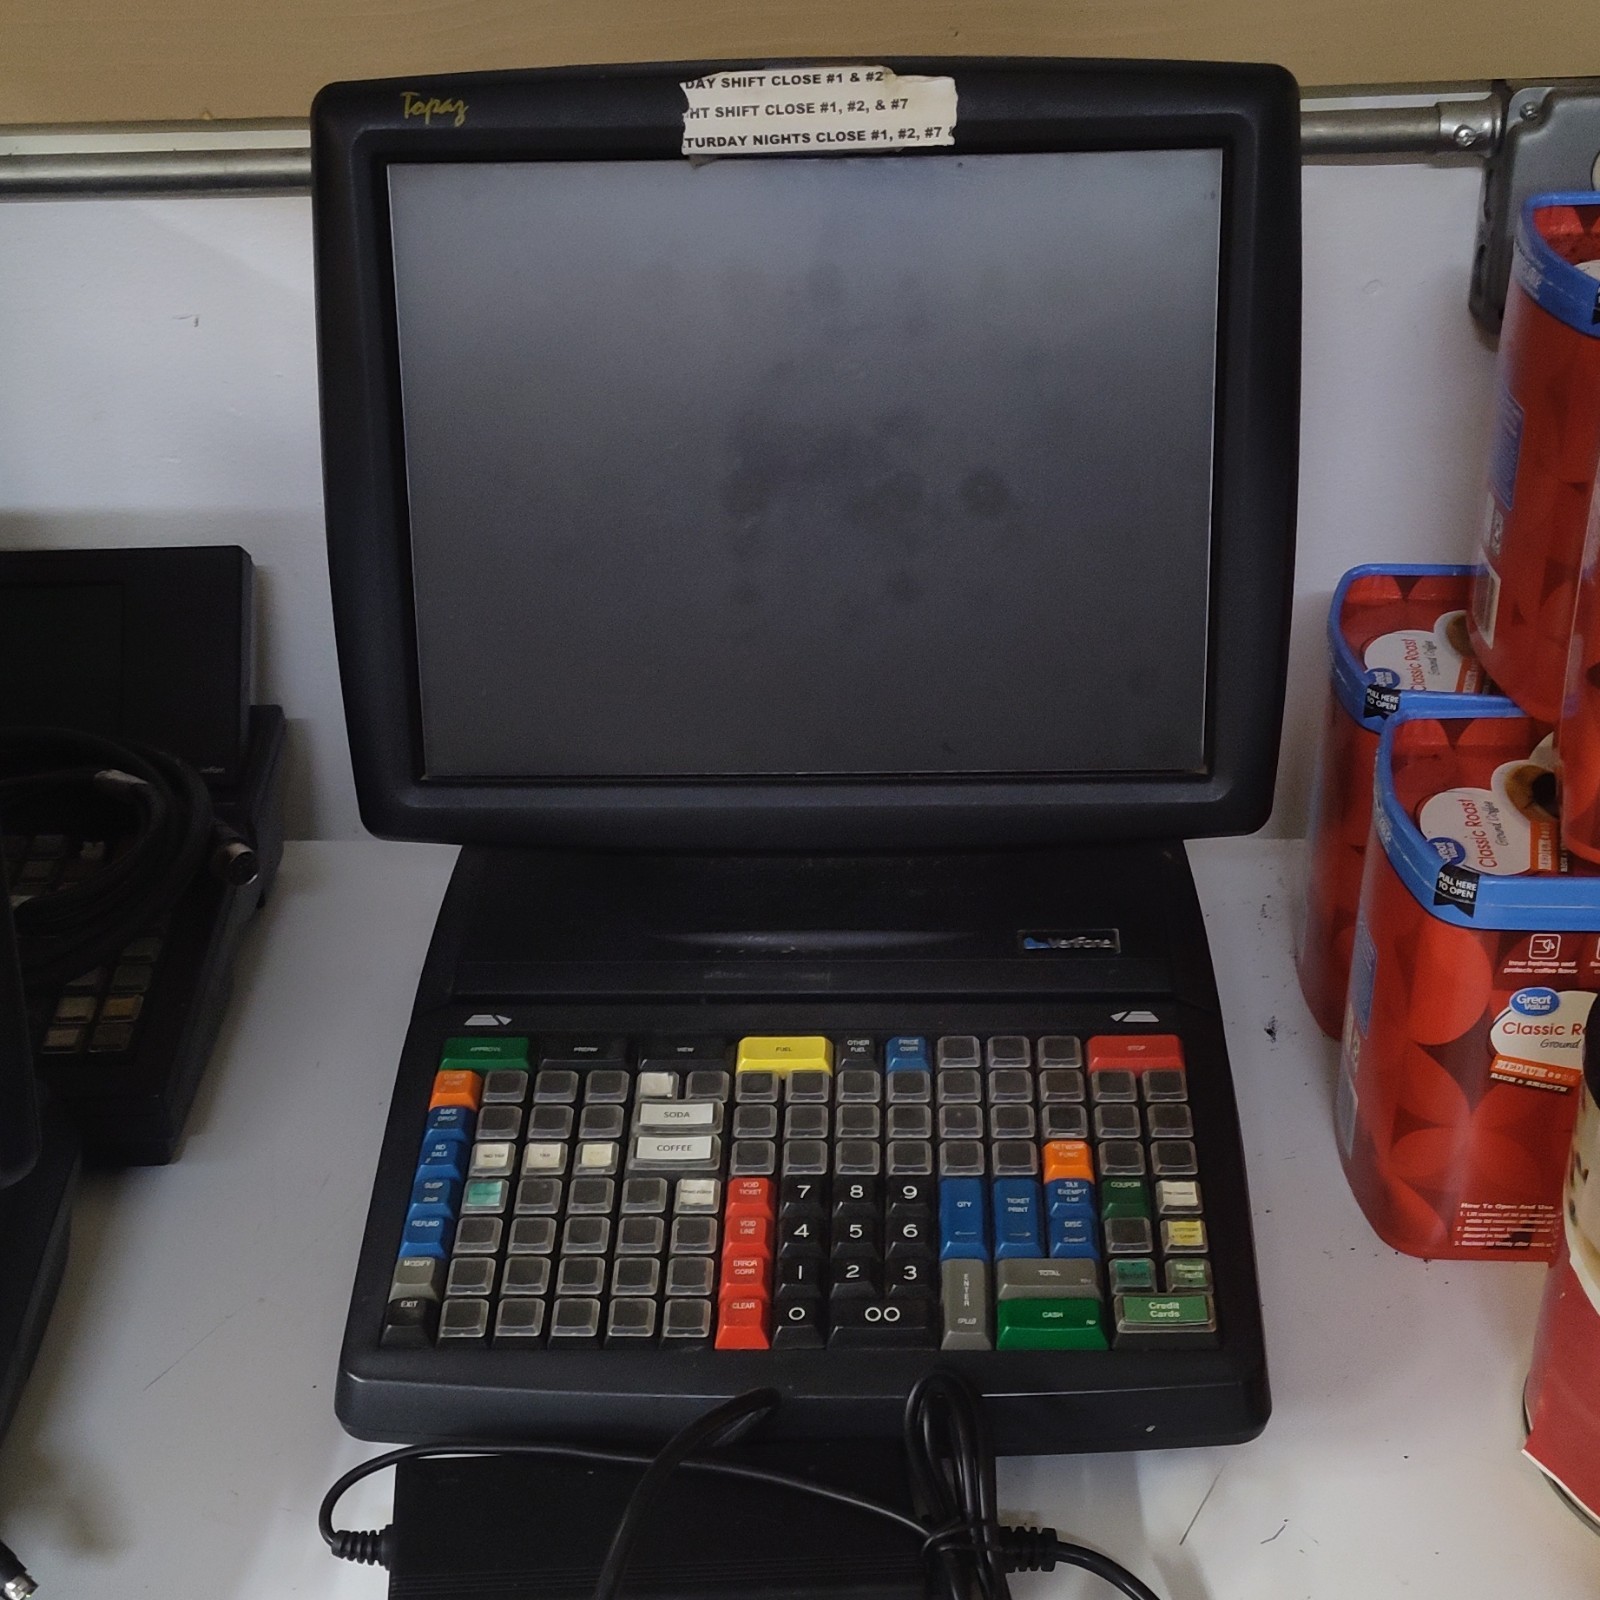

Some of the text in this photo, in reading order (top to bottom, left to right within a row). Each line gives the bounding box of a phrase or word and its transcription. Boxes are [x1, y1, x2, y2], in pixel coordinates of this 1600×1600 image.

[685, 71, 884, 89] DAY SHIFT CLOSE #1 & #2
[400, 91, 469, 128] Topaz
[715, 105, 760, 118] SHIFT
[765, 102, 815, 116] CLOSE
[819, 101, 843, 115] #1,
[847, 100, 870, 113] #2,
[875, 99, 886, 111] &
[890, 98, 908, 110] #7
[753, 132, 811, 146] NIGHTS
[816, 130, 866, 143] CLOSE
[870, 129, 893, 142] #1,
[897, 128, 920, 141] #2,
[924, 127, 942, 138] #7
[1366, 687, 1399, 704] PULL HERE
[1366, 696, 1397, 711] TO OPEN
[1457, 798, 1498, 869] Classic Roast
[1438, 872, 1477, 892] PULL HERE
[1438, 881, 1474, 899] TO OPEN
[1516, 994, 1552, 1005] Great
[1524, 1001, 1551, 1011] Value
[1502, 1021, 1565, 1036] Classic
[1539, 1039, 1581, 1049] Ground
[657, 1144, 693, 1152] COFFEE
[797, 1185, 811, 1199] 7
[849, 1184, 864, 1199] 8
[902, 1185, 918, 1199] 9
[793, 1223, 810, 1238] 4
[849, 1224, 863, 1239] 5
[902, 1223, 918, 1238] 6
[845, 1264, 860, 1279] 2
[903, 1265, 918, 1280] 3
[400, 1300, 418, 1308] EXIT
[788, 1306, 806, 1321] 0
[864, 1306, 901, 1322] 00
[1149, 1310, 1180, 1318] Cards
